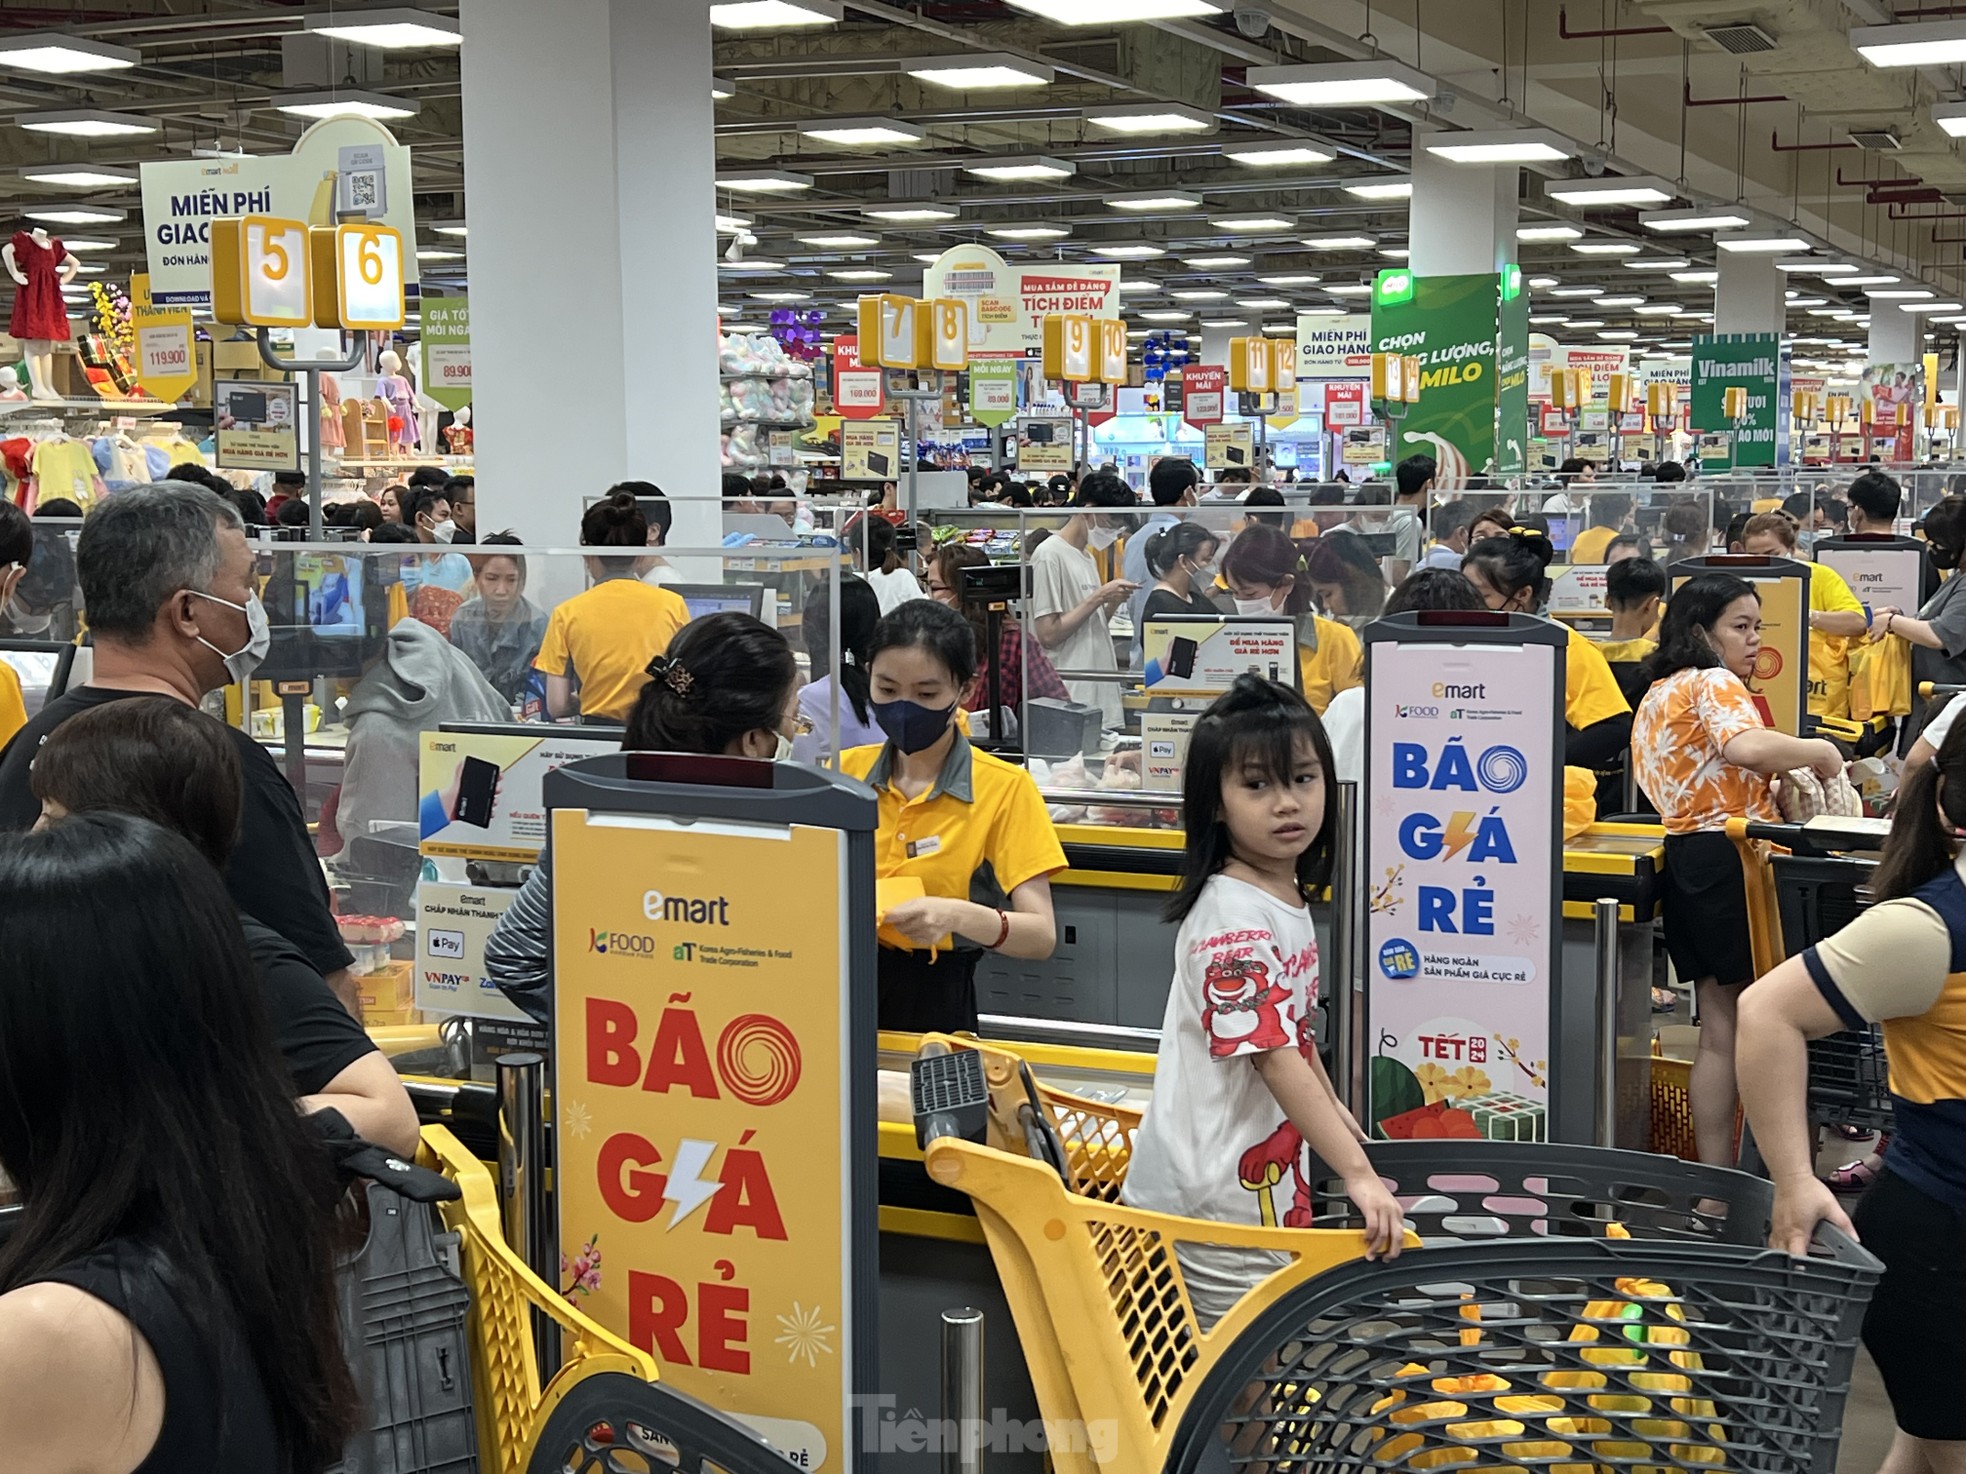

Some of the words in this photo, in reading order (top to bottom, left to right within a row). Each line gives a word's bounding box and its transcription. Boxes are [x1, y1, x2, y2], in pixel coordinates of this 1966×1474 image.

[171, 188, 228, 216] MIỄN
[234, 185, 271, 214] PHÍ
[163, 255, 185, 266] ĐƠN
[187, 255, 208, 265] HÀN
[262, 225, 288, 280] 5
[358, 231, 383, 285] 6
[1046, 281, 1065, 291] SẮM
[1080, 282, 1106, 290] DÀNG
[165, 295, 200, 303] DOWNLOAD
[1022, 295, 1059, 311] TÍCH
[1063, 293, 1103, 310] ĐIỂM
[429, 307, 448, 321] GIÁ
[451, 307, 469, 321] TỐ
[887, 300, 905, 339] 7
[942, 303, 957, 340] 8
[426, 322, 446, 335] MỖI
[448, 323, 470, 336] NGÀ
[1072, 321, 1083, 353] 9
[1312, 329, 1344, 341] MIỄN
[1346, 328, 1367, 341] PHÍ
[1105, 324, 1122, 357] 10
[1378, 331, 1426, 351] CHỌN
[151, 350, 185, 365] 119.900
[1251, 342, 1263, 369] 11
[1279, 343, 1293, 370] 12
[1303, 345, 1335, 355] GIAO
[1186, 371, 1221, 381] KHUYẾN
[1419, 362, 1483, 390] MILO
[1650, 369, 1673, 377] MIỄN
[1675, 368, 1690, 377] PHÍ
[1698, 357, 1775, 378] Vinamilk
[1852, 572, 1883, 582] emart
[1261, 638, 1284, 646] HÀNG
[1432, 682, 1486, 699] emart
[1409, 705, 1439, 716] FOOD
[1450, 708, 1465, 719] aT
[429, 741, 456, 752] emart
[1393, 735, 1528, 794] BÃO
[460, 895, 486, 906] emart
[642, 889, 729, 926] emart
[1418, 875, 1495, 936] RẺ
[424, 903, 447, 913] CHẤP
[447, 906, 471, 918] NHẬN
[472, 909, 498, 919] THANH
[441, 937, 460, 952] Pay
[609, 933, 655, 954] FOOD
[673, 942, 697, 962] aT
[699, 945, 718, 954] Korea
[774, 950, 793, 959] Food
[699, 955, 717, 965] Trade
[719, 957, 759, 967] Corporation
[1424, 954, 1450, 965] HÀNG
[1452, 956, 1479, 967] NGÀN
[424, 971, 462, 985] VNPAY
[1424, 965, 1443, 976] SẢN
[1444, 966, 1470, 978] PHẨM
[1472, 969, 1490, 980] GIÁ
[1492, 972, 1512, 983] CỰC
[1515, 971, 1526, 982] RẺ
[585, 991, 803, 1107] BÃO
[1418, 1033, 1467, 1060] TẾT
[1470, 1039, 1485, 1050] 20
[1470, 1050, 1485, 1061] 24
[628, 1259, 751, 1376] RẺ
